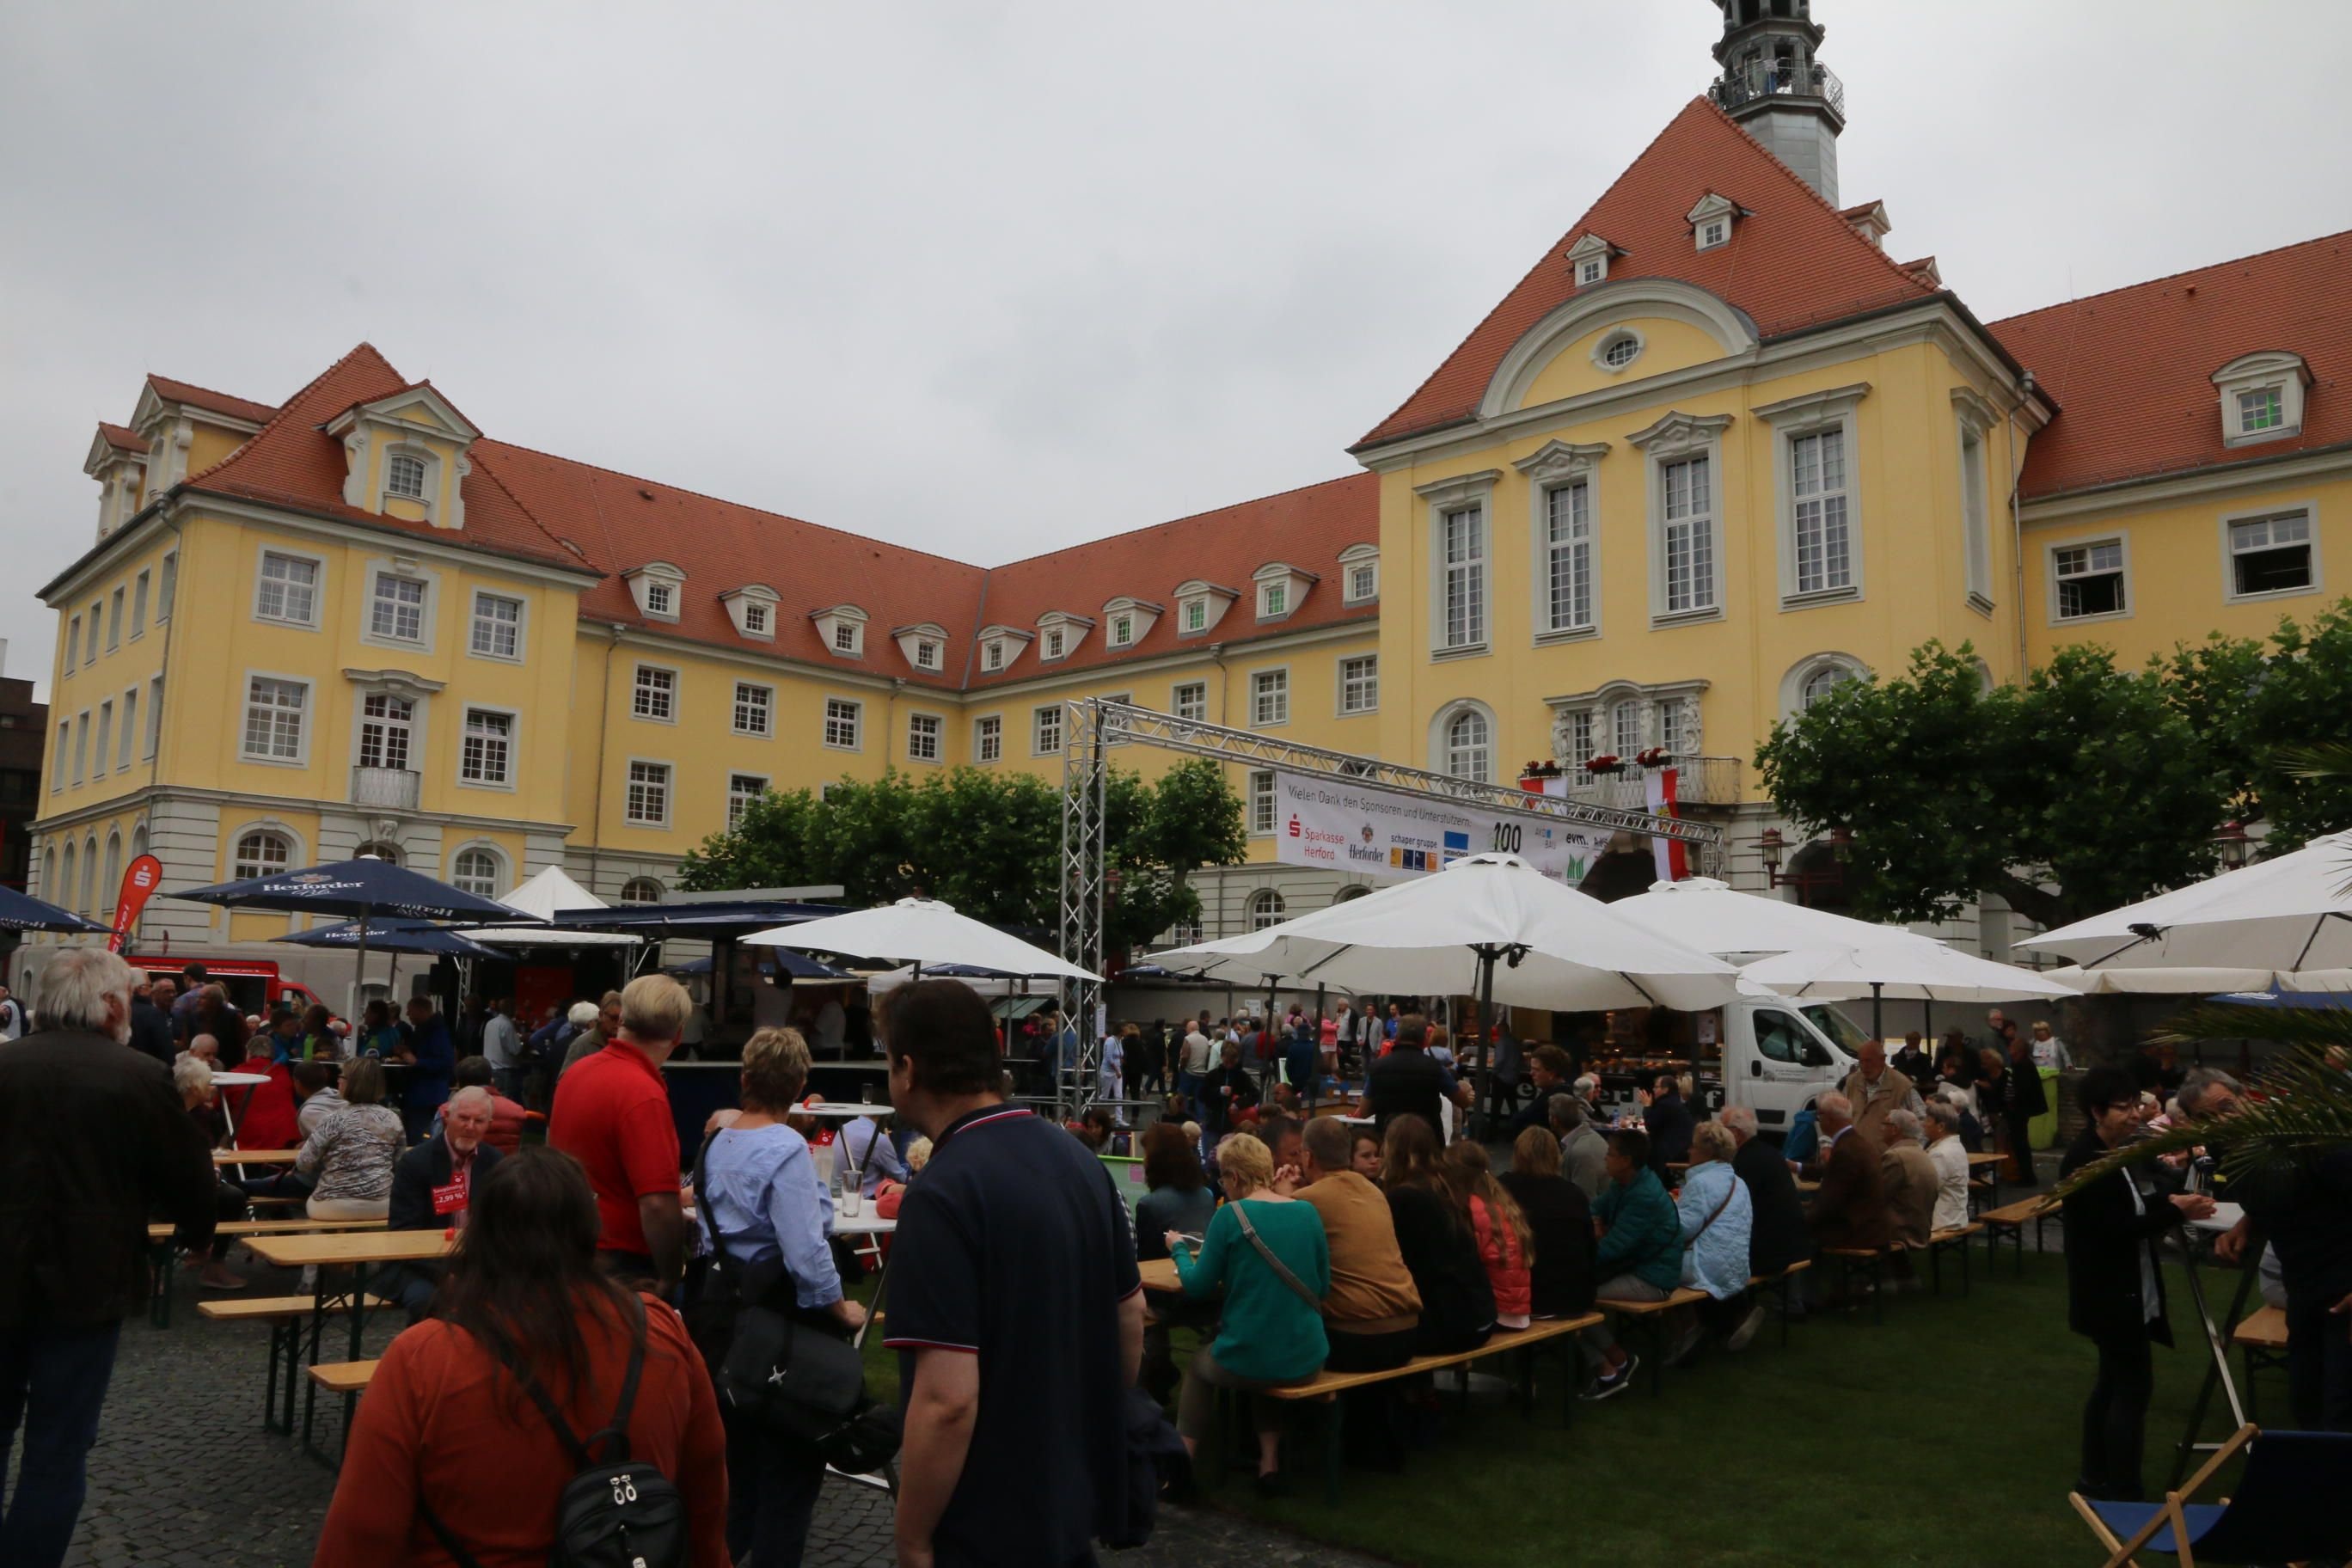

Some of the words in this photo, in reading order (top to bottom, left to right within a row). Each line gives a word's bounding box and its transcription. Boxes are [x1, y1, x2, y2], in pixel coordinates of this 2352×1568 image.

[1289, 785, 1316, 801] Vielen
[1319, 791, 1341, 805] Dank
[1343, 796, 1357, 808] den
[1361, 798, 1402, 815] Sponsoren
[1404, 807, 1418, 819] und
[1419, 811, 1472, 827] Unterstützern:
[1305, 827, 1344, 844] Sparkasse
[1391, 834, 1415, 847] schaper
[1417, 839, 1437, 848] gruppe
[1494, 822, 1522, 854] 100
[1305, 846, 1335, 861] Herford
[1350, 844, 1384, 862] Herforder
[263, 880, 365, 891] Herforder
[325, 929, 388, 940] Herfoder
